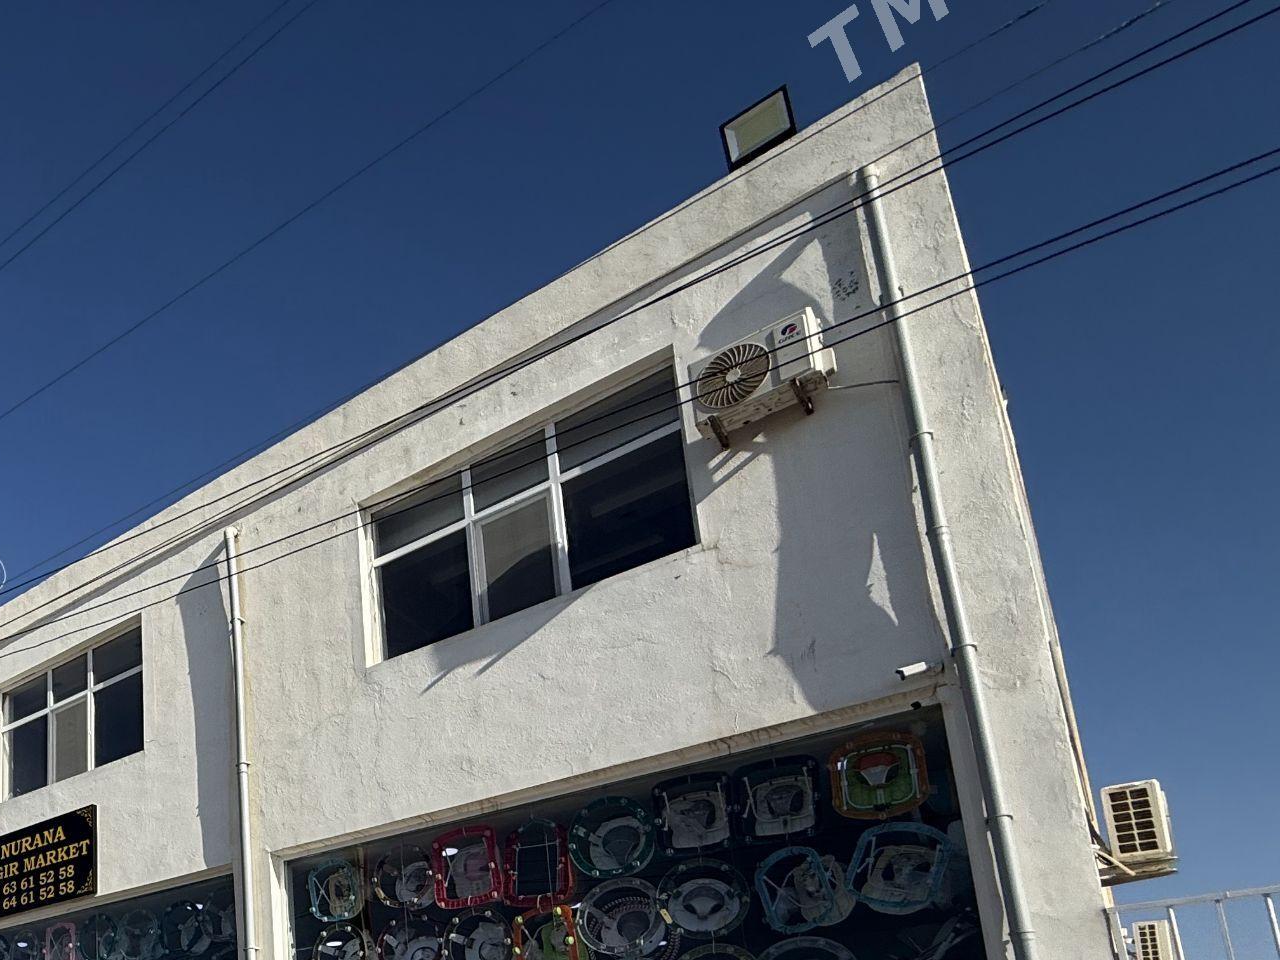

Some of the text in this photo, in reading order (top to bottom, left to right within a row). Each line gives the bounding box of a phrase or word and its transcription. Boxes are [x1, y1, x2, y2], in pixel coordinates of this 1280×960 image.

[0, 825, 66, 860] NURANA
[22, 838, 91, 873] MARKET
[2, 881, 17, 896] 63
[20, 876, 35, 890] 61
[39, 870, 55, 885] 52
[58, 864, 75, 880] 58
[2, 896, 17, 910] 64
[20, 891, 35, 905] 61
[39, 885, 55, 900] 52
[58, 880, 75, 896] 58
